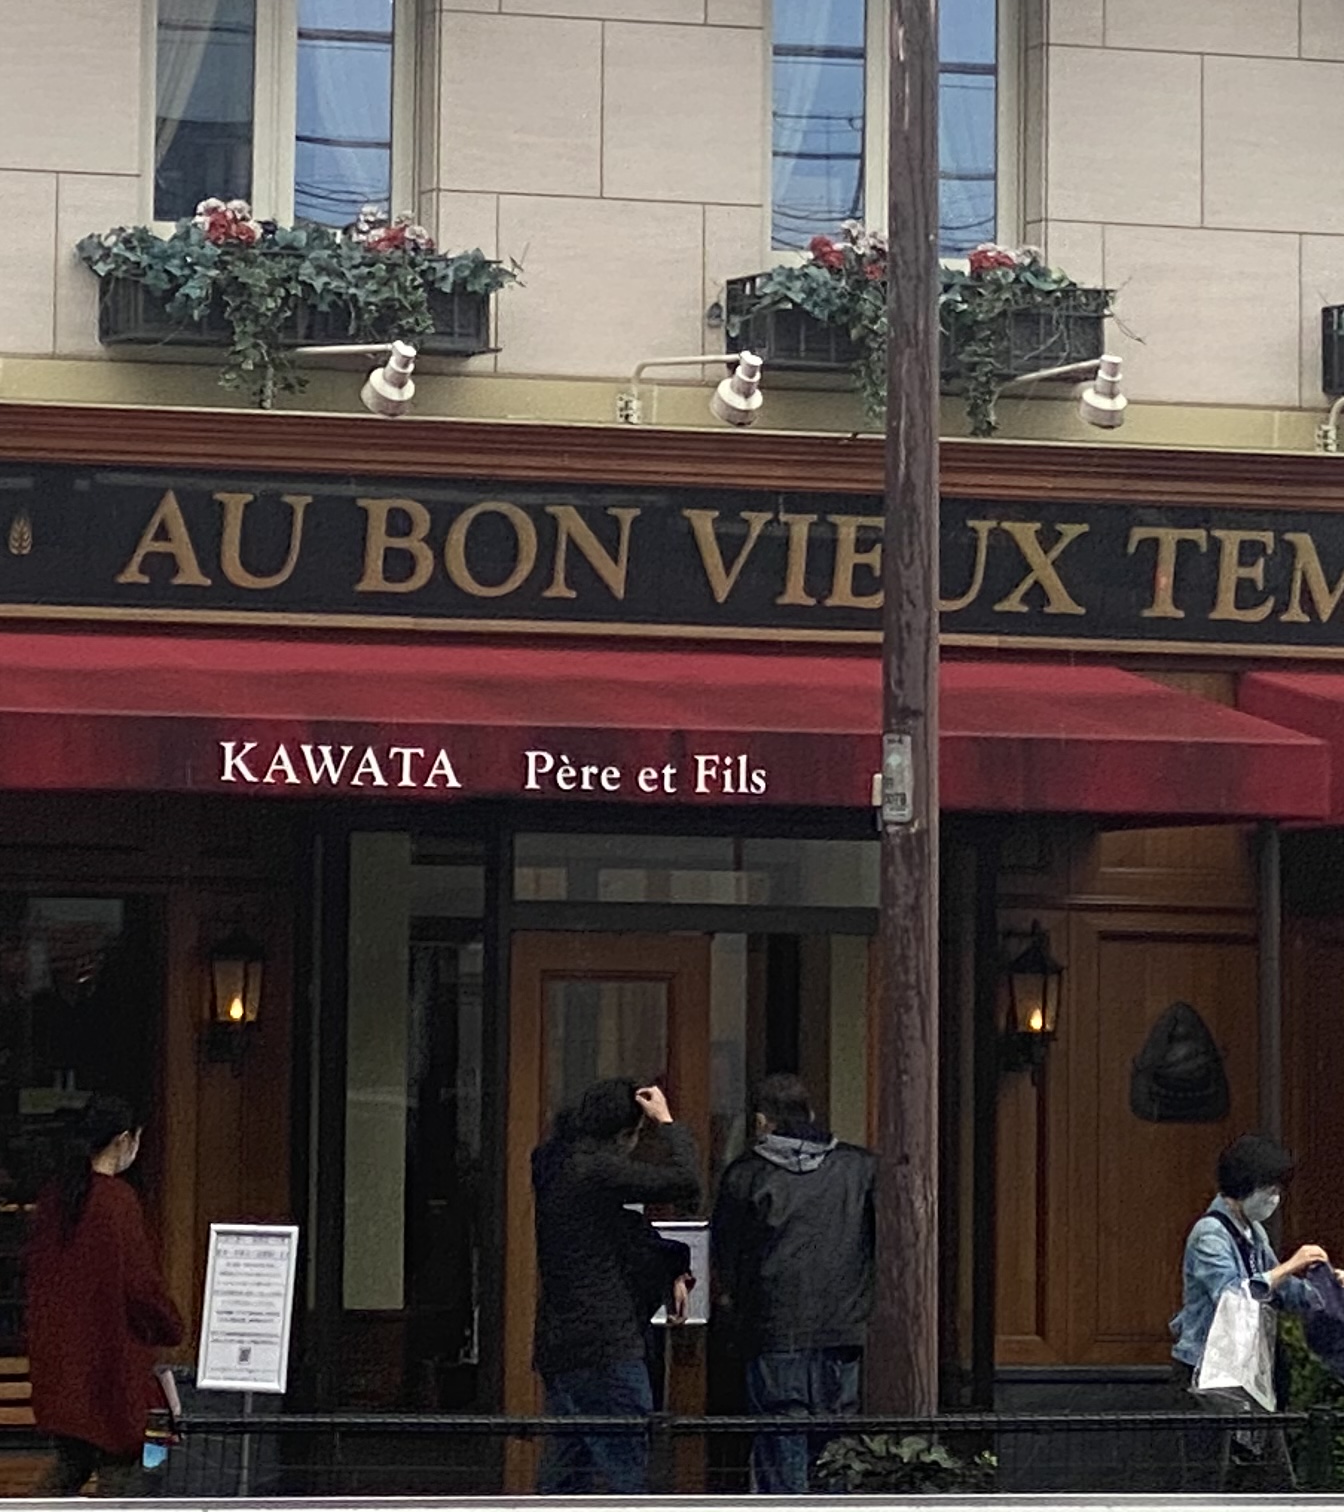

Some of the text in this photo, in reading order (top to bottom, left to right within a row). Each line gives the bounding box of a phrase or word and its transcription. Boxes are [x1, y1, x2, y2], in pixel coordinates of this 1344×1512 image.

[115, 488, 313, 589] AU
[355, 496, 642, 600] BON
[219, 741, 768, 796] KAWATA Père et Fils
